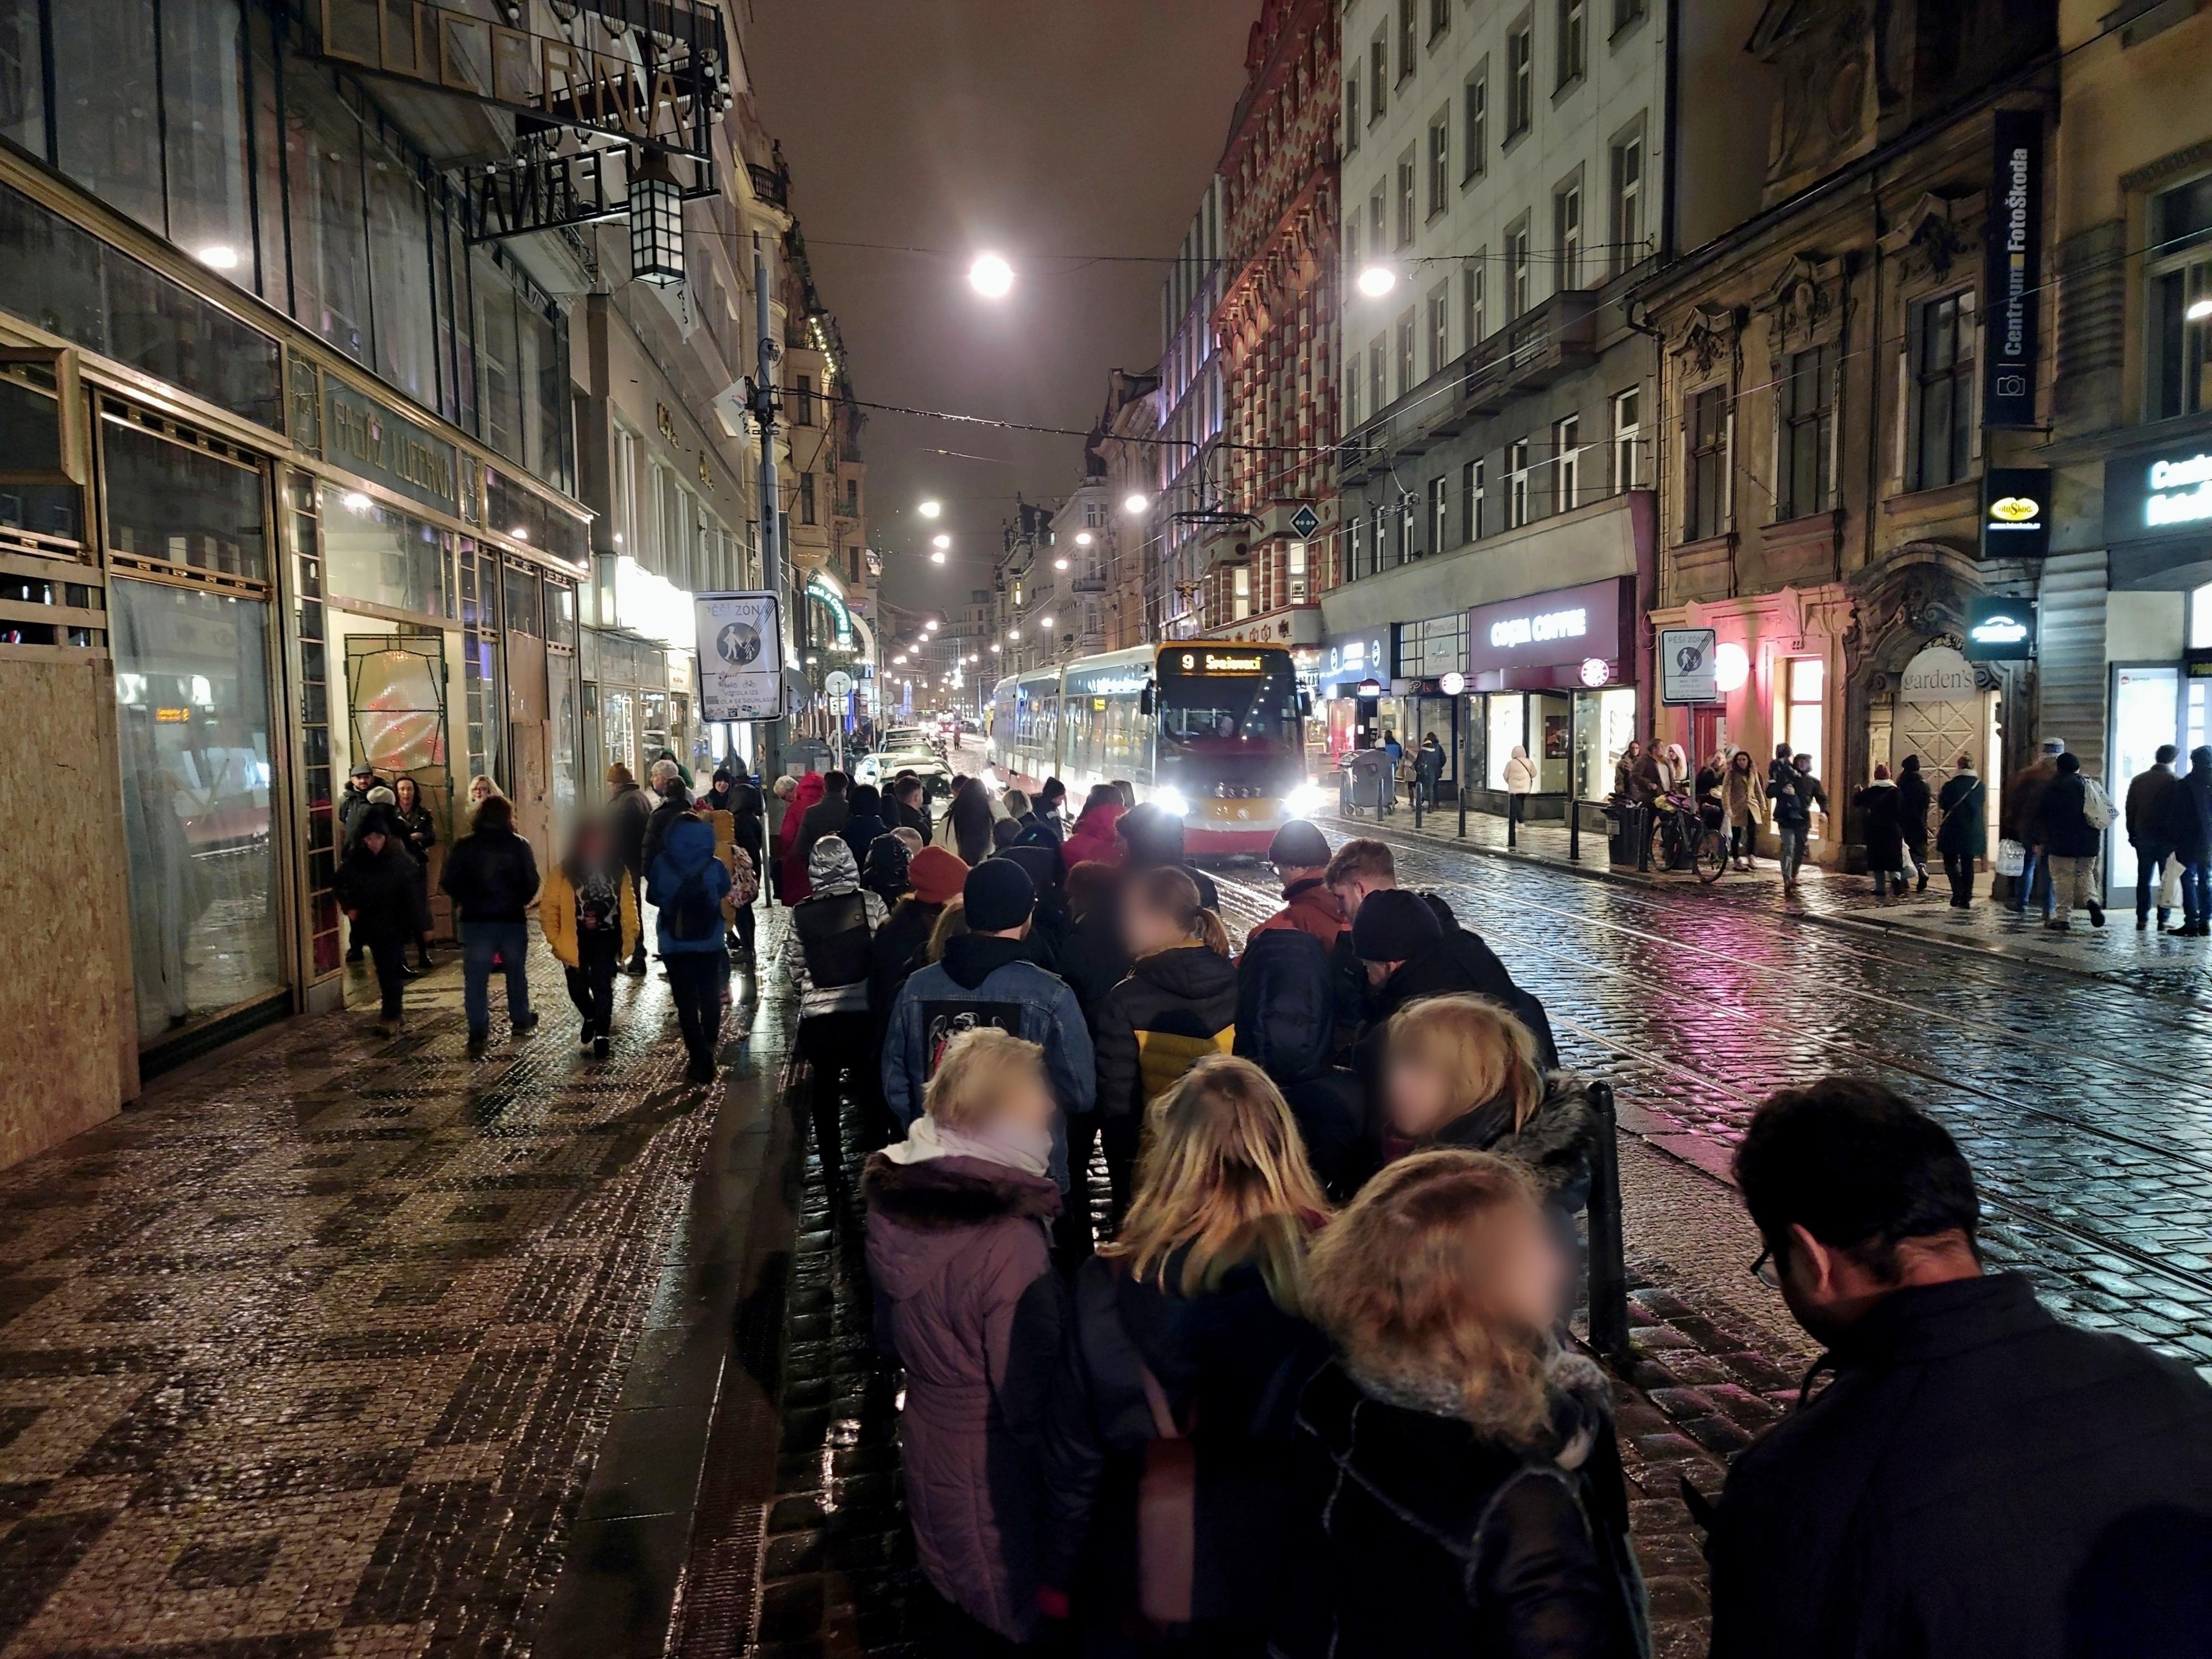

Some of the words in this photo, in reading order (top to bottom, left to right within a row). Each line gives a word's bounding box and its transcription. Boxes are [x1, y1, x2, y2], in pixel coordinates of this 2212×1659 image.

[2005, 148, 2028, 251] FotoŠkoda
[2005, 269, 2024, 356] Centrum
[735, 603, 770, 615] ZÓN
[1182, 655, 1194, 669] 9
[1904, 669, 1972, 690] garden's
